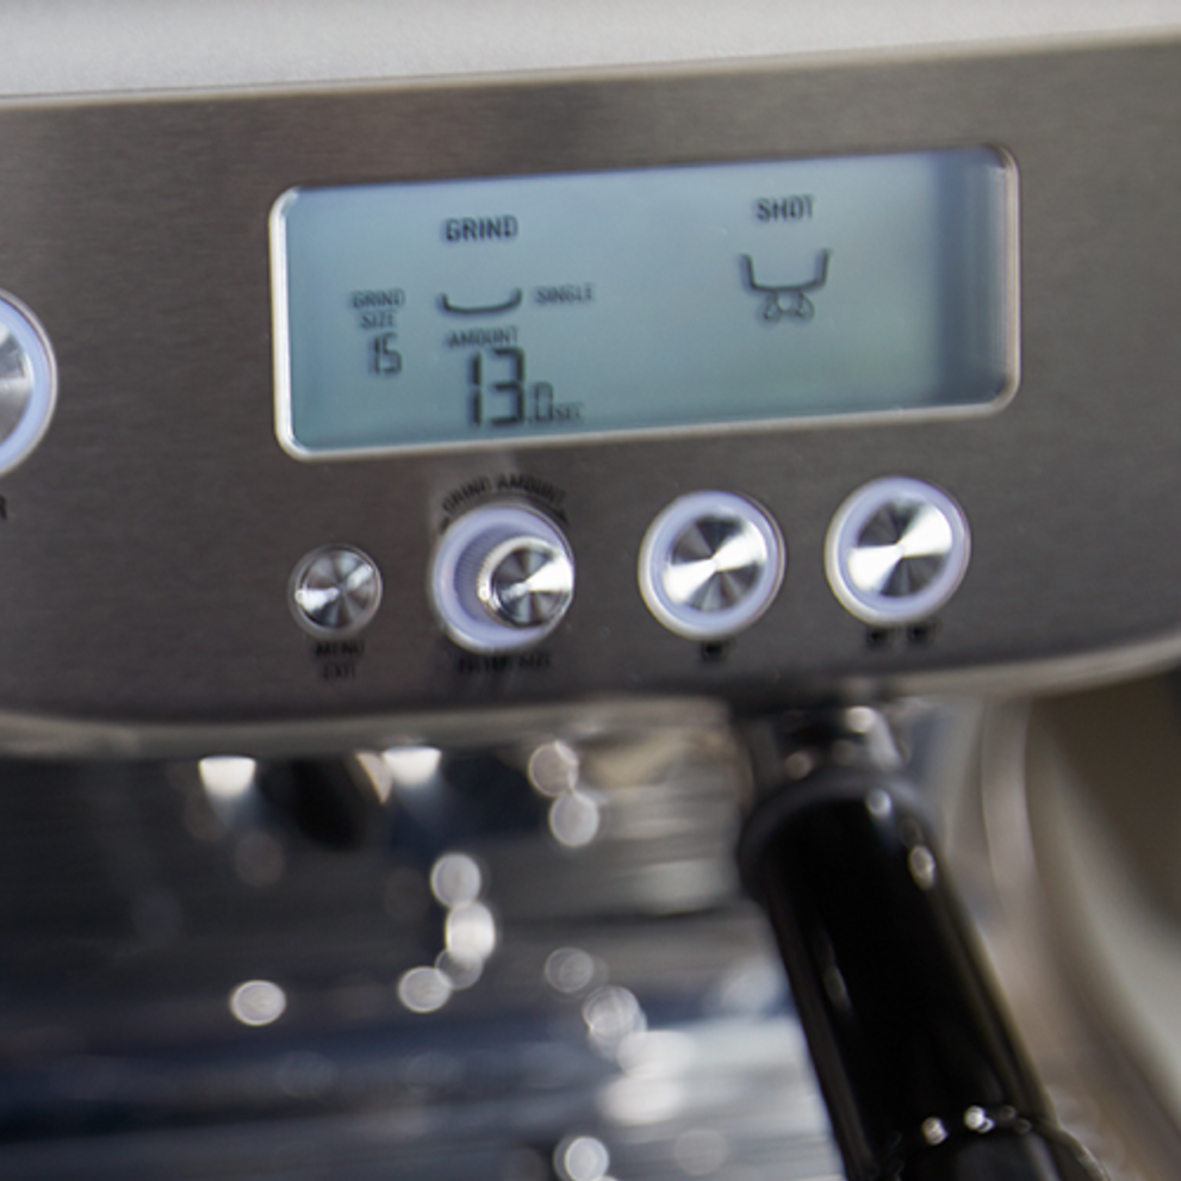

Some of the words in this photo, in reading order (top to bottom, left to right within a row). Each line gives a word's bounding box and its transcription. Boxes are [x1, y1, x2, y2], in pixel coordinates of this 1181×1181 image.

[755, 194, 815, 223] SHOT
[444, 215, 518, 242] GRIND
[351, 288, 405, 310] GRIND
[534, 283, 593, 304] SINGLE
[361, 311, 396, 330] SIZE
[447, 326, 517, 348] AMOUNT
[373, 332, 402, 374] 15
